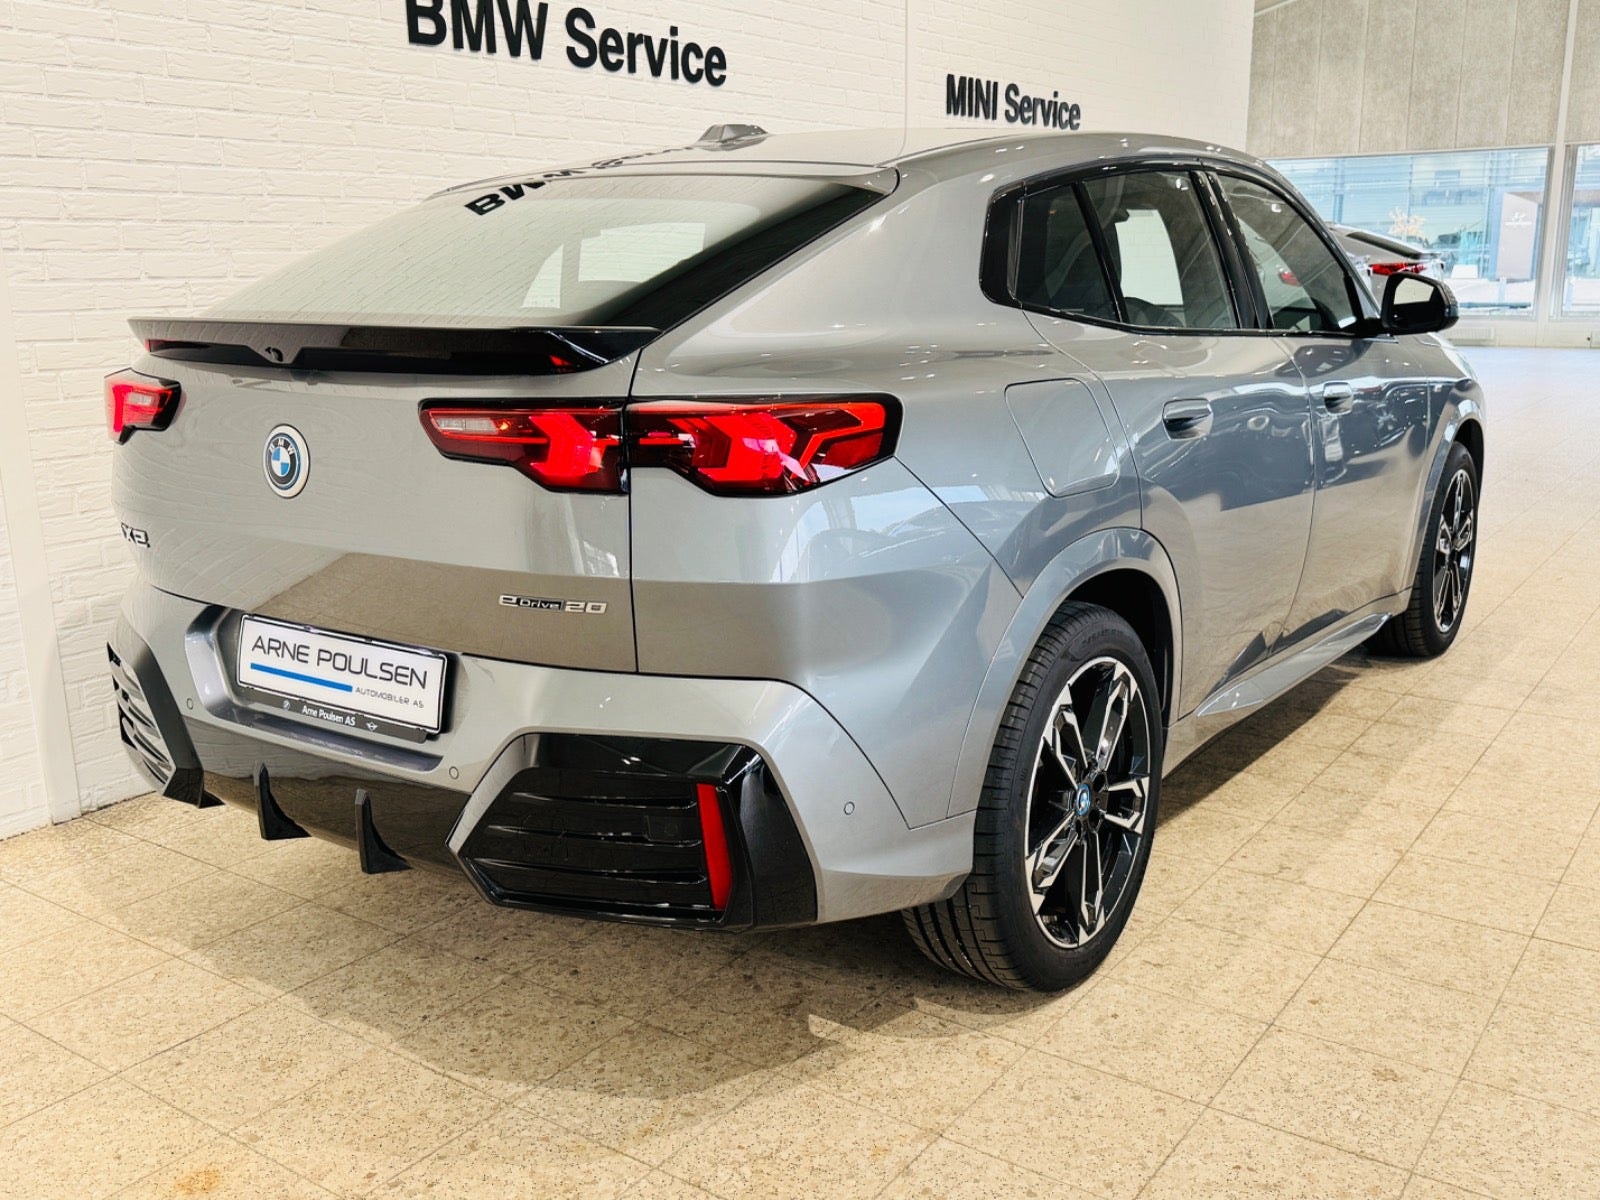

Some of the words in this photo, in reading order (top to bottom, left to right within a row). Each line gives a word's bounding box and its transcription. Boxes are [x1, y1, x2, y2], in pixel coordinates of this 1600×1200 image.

[406, 0, 549, 60] BMW
[565, 7, 727, 87] Service
[946, 73, 999, 120] MINI
[1004, 83, 1081, 130] Service
[251, 635, 311, 665] ARNE
[316, 648, 428, 690] POULSEN
[301, 704, 318, 718] Arne
[318, 708, 345, 725] Poulsen
[344, 714, 357, 727] AS
[355, 686, 410, 705] AUTOMOBILER
[412, 699, 425, 709] AS
